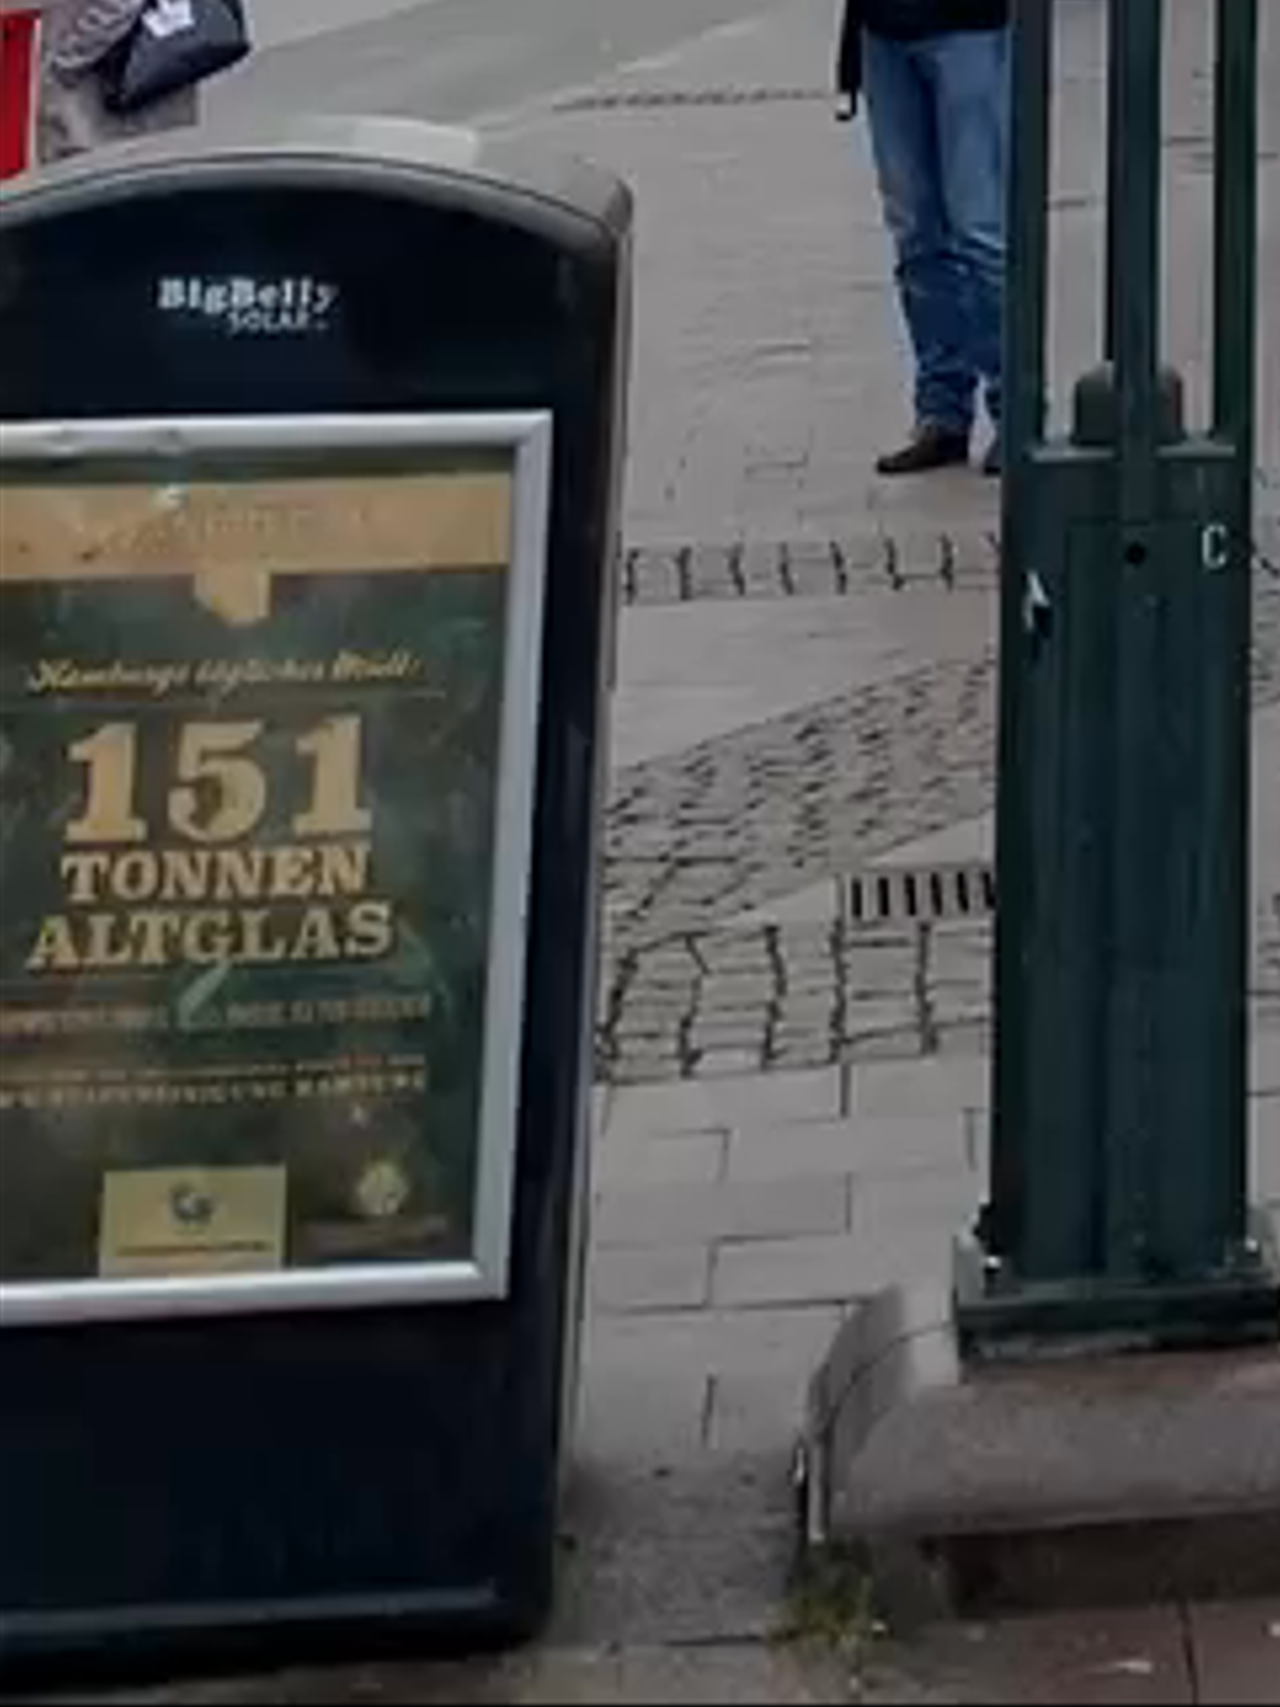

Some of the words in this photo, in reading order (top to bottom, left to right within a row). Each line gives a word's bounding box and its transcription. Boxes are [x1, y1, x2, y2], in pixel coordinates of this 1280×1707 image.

[157, 276, 340, 314] BigBelly
[64, 714, 372, 843] 151
[61, 841, 371, 902] TONNEN
[25, 900, 395, 970] ALTGLAS
